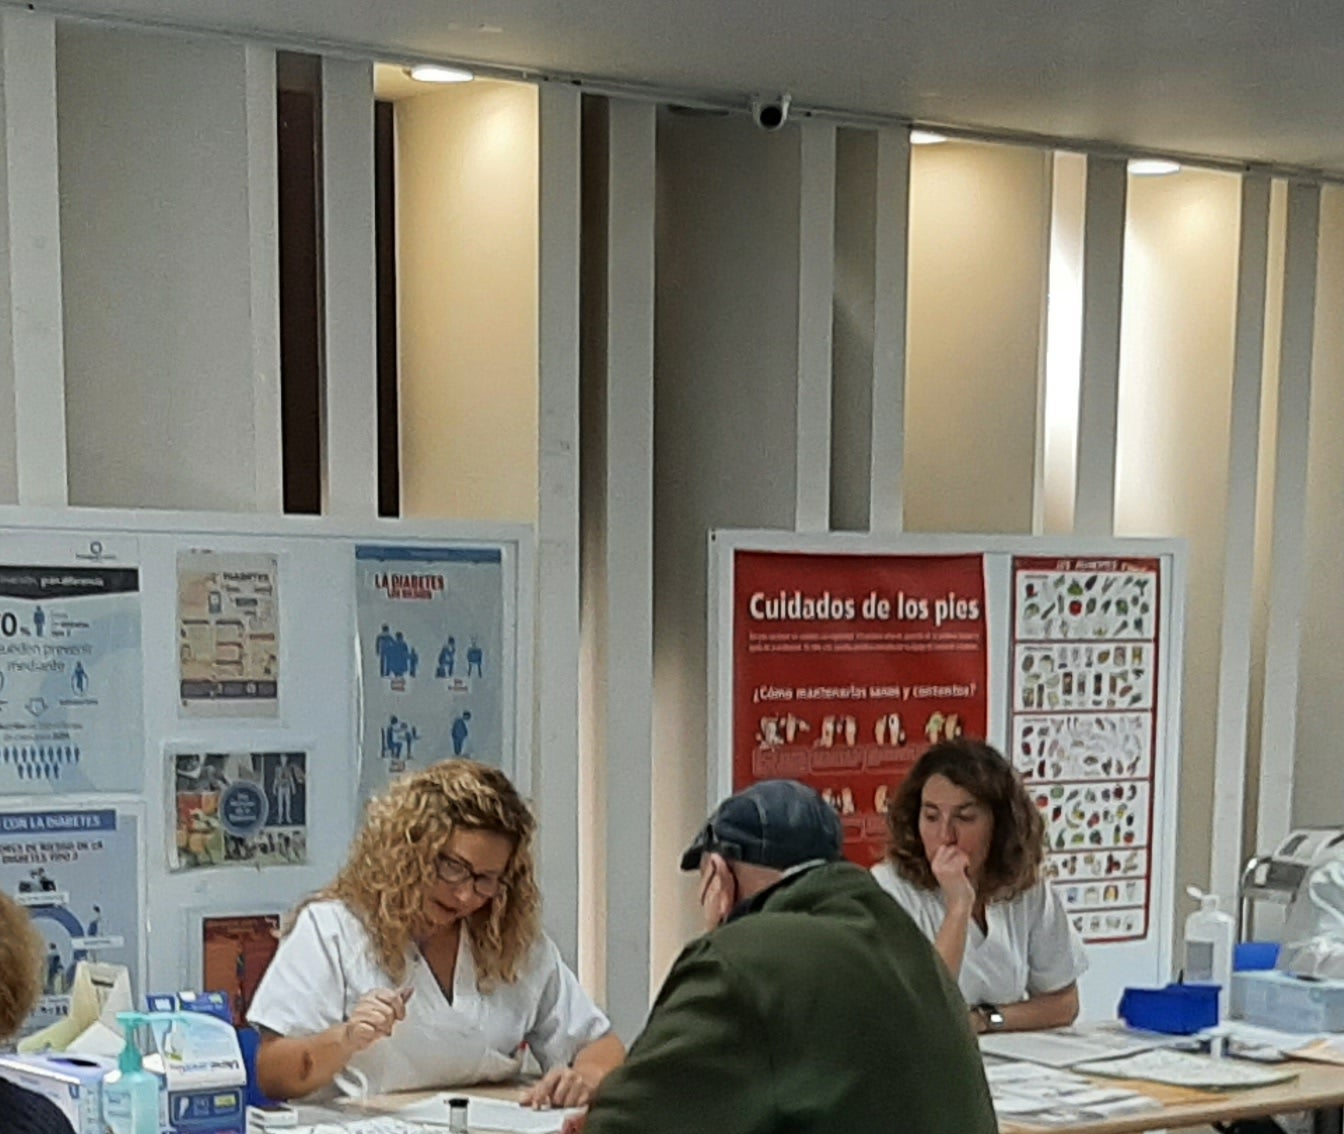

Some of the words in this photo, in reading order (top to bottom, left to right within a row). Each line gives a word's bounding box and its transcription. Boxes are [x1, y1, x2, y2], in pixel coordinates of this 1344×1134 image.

[749, 590, 855, 620] Cuidados
[862, 591, 890, 620] de
[897, 591, 929, 620] los
[935, 591, 981, 627] pies
[3, 818, 28, 831] CON
[30, 816, 46, 829] LA
[46, 814, 101, 829] DIABETES
